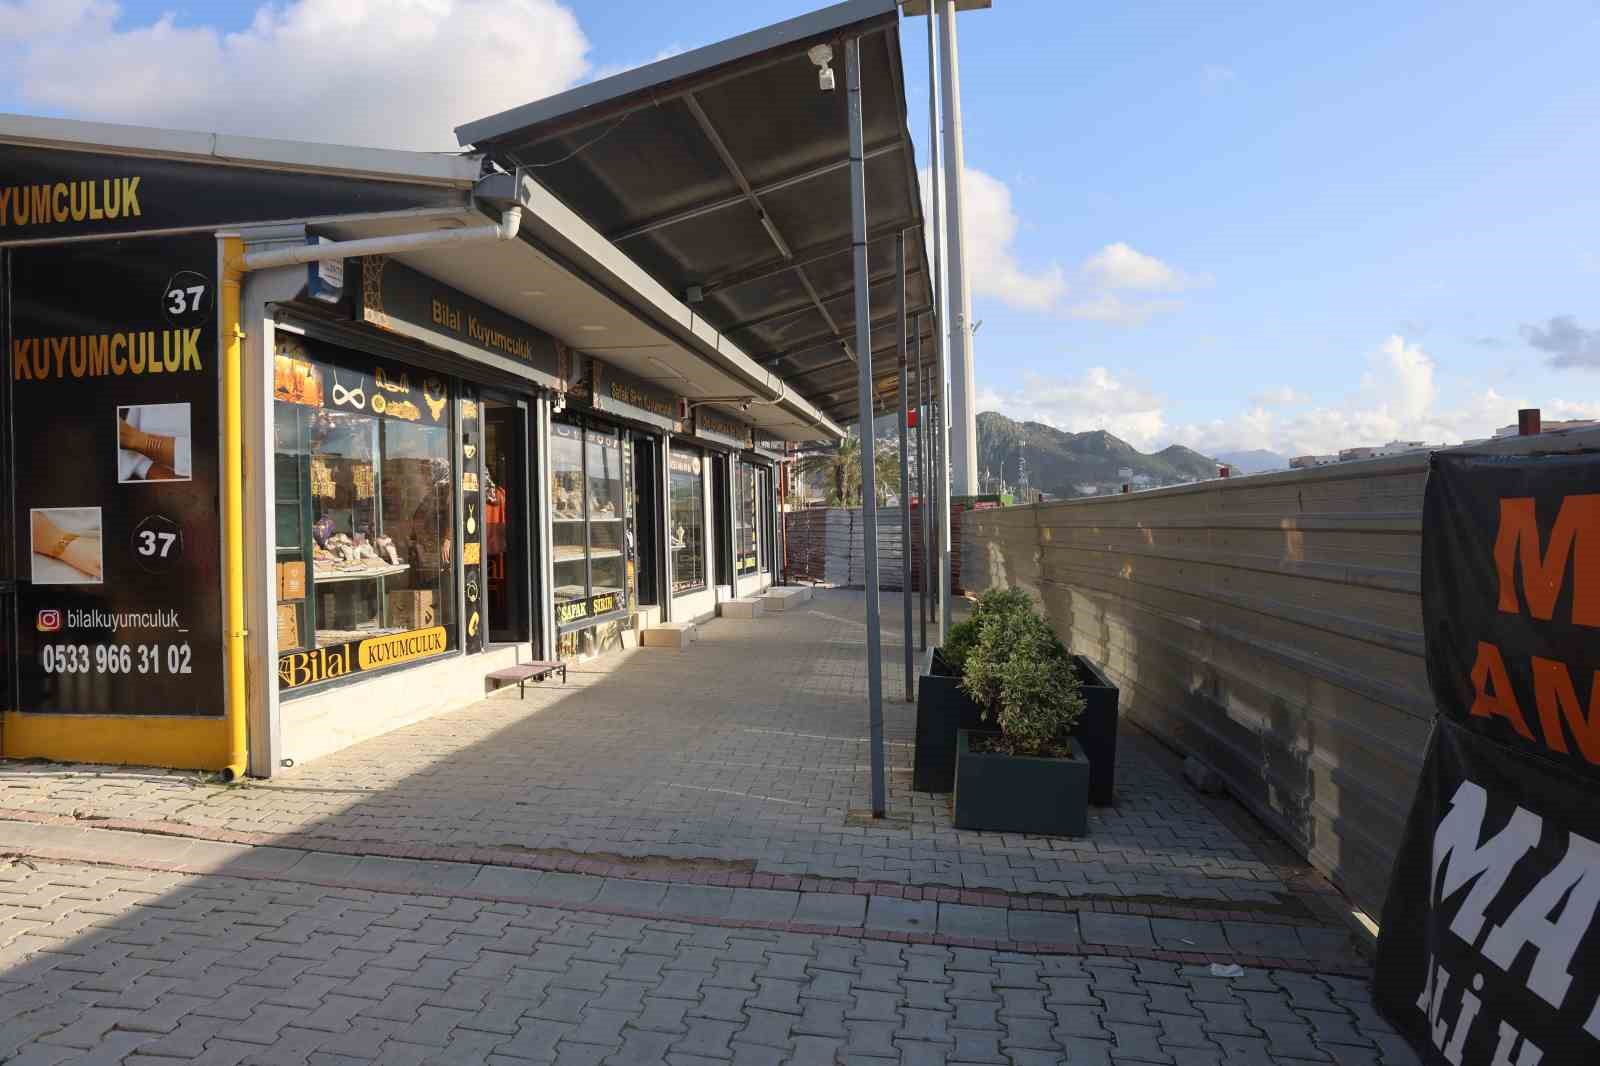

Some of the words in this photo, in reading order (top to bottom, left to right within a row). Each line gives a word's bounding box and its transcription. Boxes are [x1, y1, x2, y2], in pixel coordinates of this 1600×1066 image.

[168, 285, 205, 315] 37
[431, 300, 462, 332] Bilal
[468, 315, 533, 361] Kuyumculuk
[14, 328, 202, 380] KUYUMCULUK
[138, 530, 176, 558] 37
[67, 609, 189, 633] bilalkuyumculuk_
[43, 644, 90, 674] 0533
[95, 644, 131, 674] 966
[137, 644, 160, 674] 31
[167, 643, 192, 674] 02
[288, 643, 351, 687] Bilal
[368, 632, 442, 664] KUYUMCULUK
